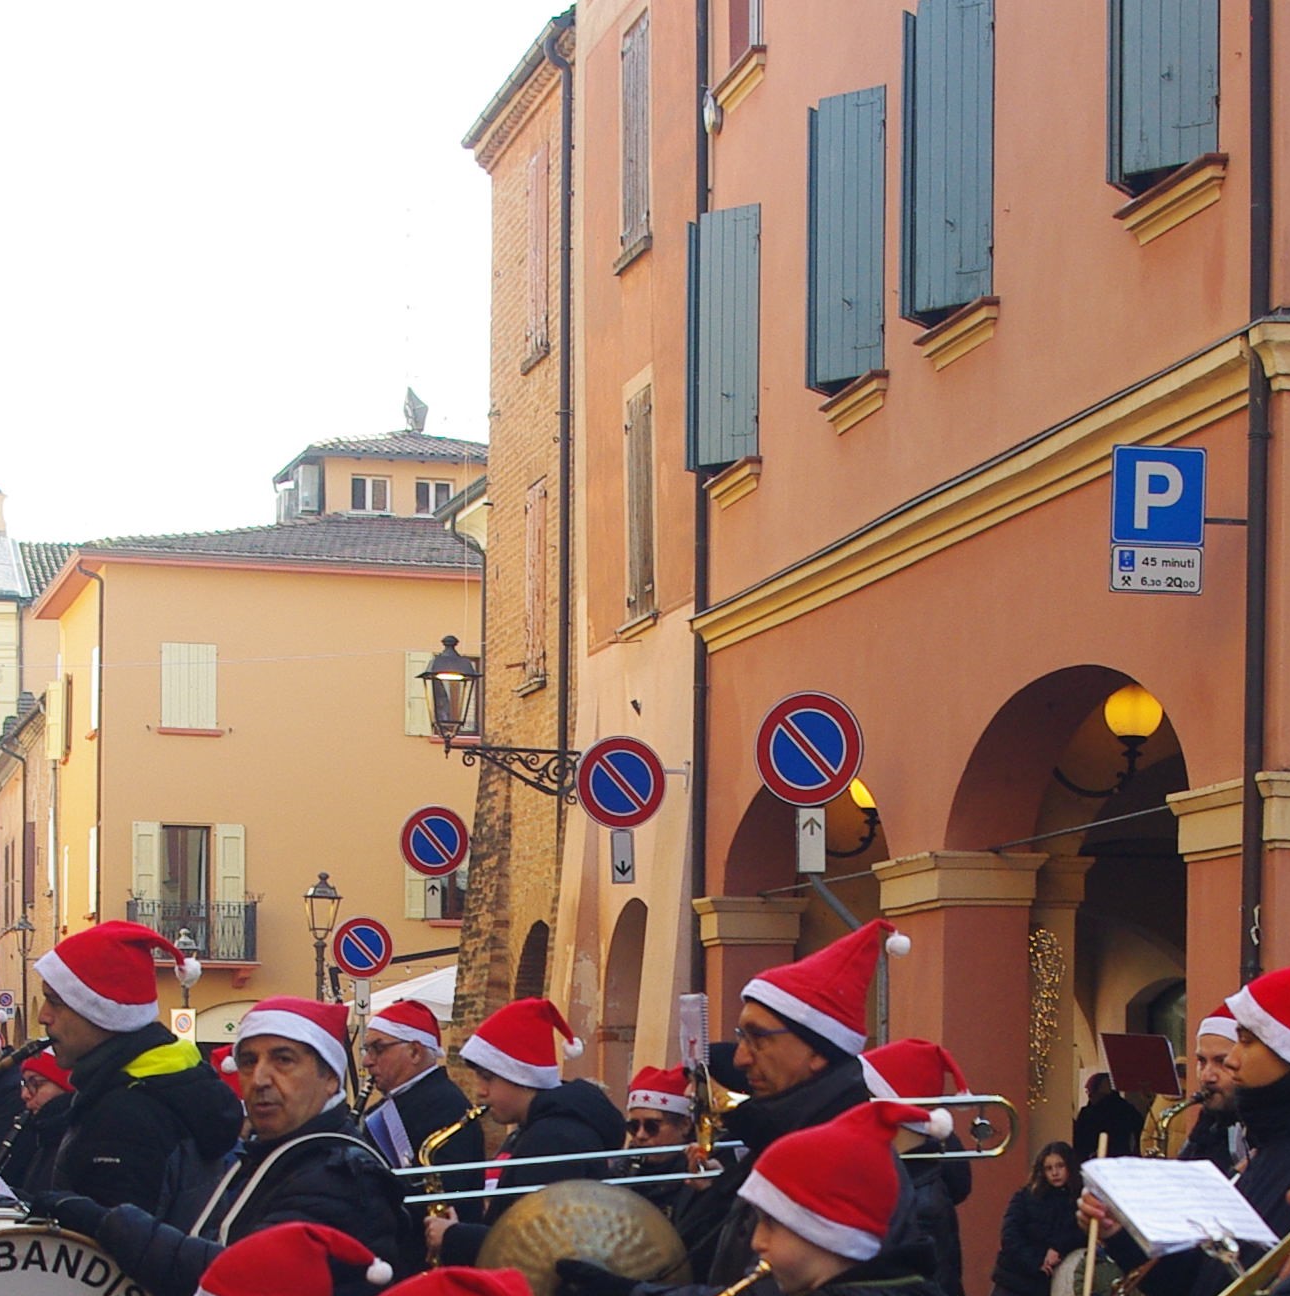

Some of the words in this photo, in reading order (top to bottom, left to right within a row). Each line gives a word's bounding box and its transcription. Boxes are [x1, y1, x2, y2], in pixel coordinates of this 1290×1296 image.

[1134, 461, 1184, 530] P
[1141, 557, 1157, 567] 45
[1161, 557, 1195, 569] minuti
